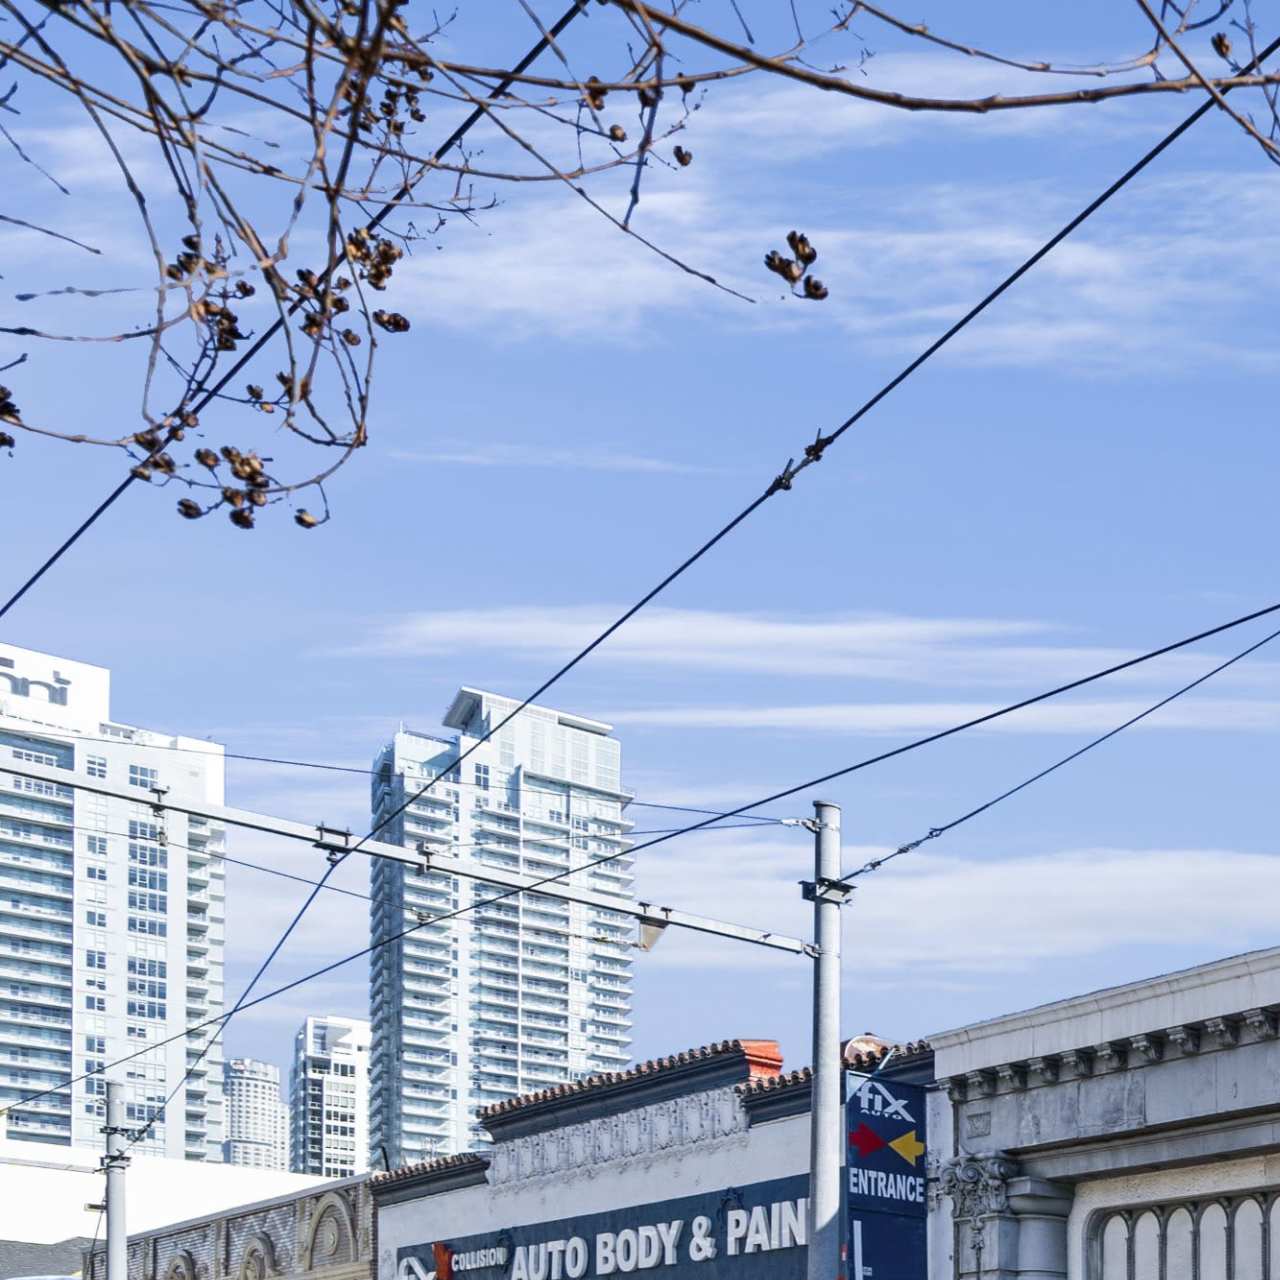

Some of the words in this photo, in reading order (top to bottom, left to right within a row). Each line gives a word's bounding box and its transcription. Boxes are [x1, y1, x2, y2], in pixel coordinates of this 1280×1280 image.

[849, 1167, 925, 1204] ENTRANCE
[595, 1219, 685, 1276] BODY
[689, 1215, 717, 1263] &
[727, 1197, 813, 1257] PAIN
[451, 1246, 508, 1273] COLLISION
